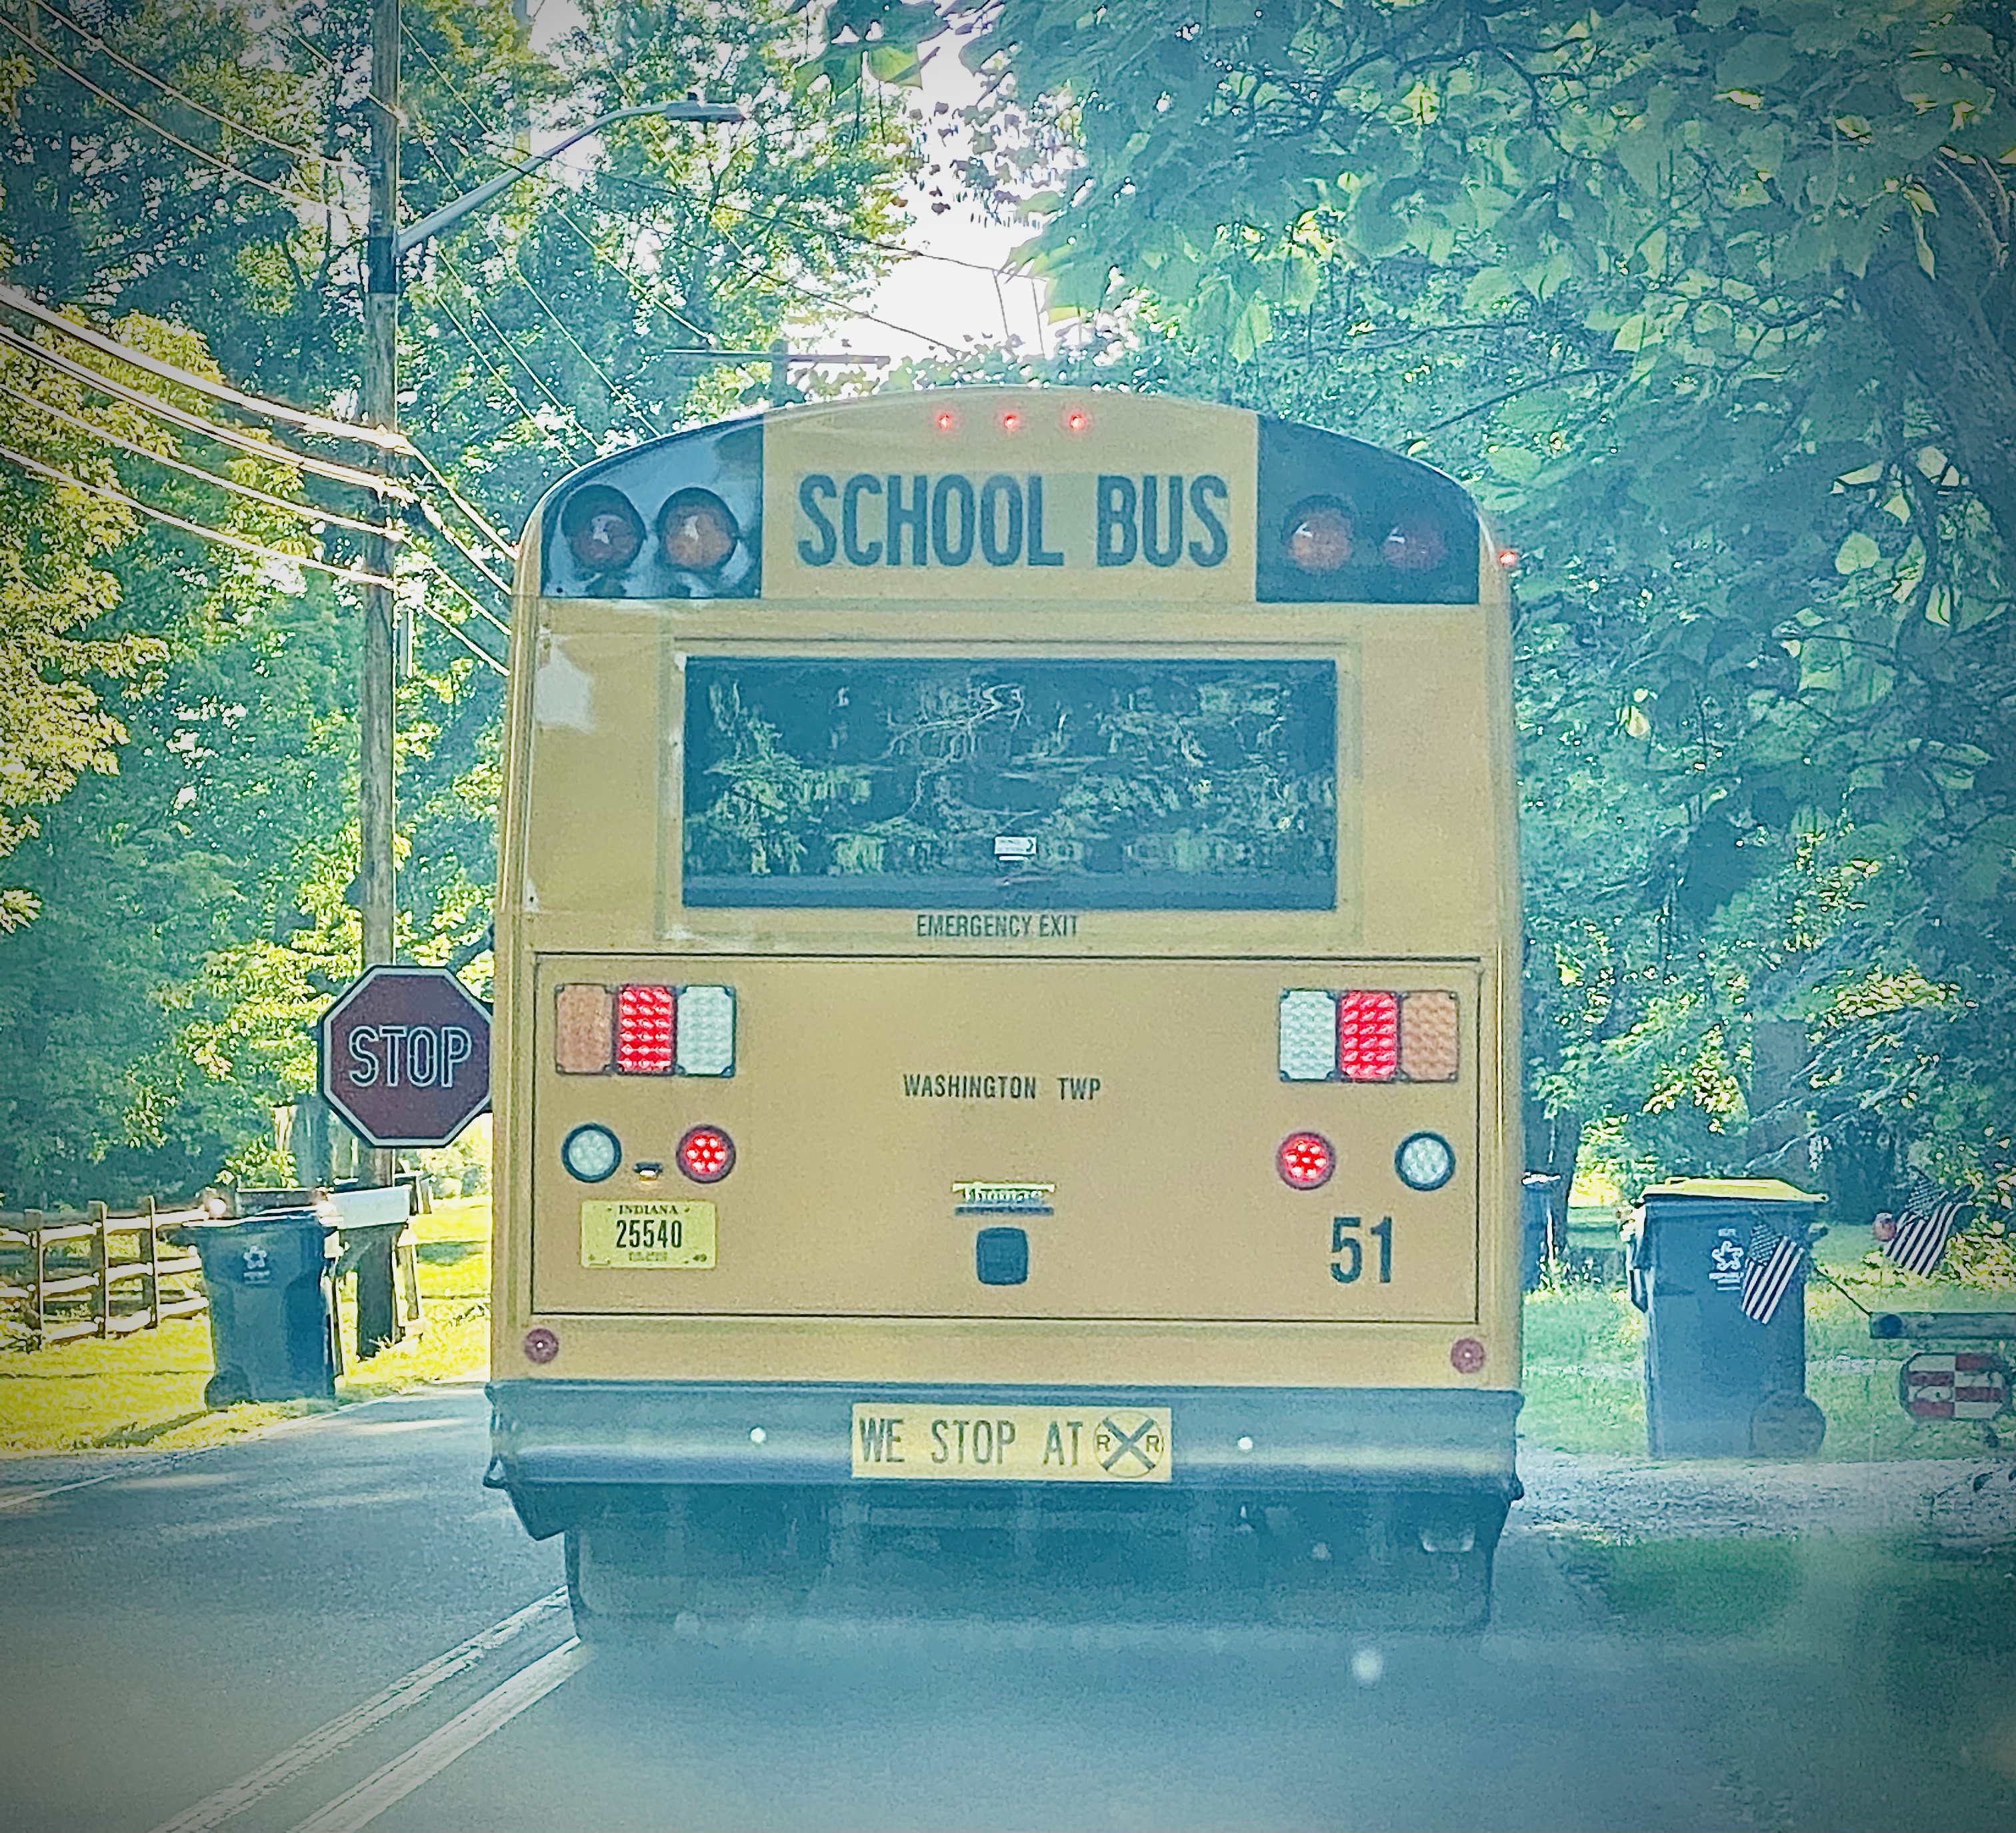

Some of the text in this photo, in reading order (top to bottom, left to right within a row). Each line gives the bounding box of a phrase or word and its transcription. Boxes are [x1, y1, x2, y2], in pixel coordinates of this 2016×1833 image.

[798, 473, 1228, 567] SCHOOL BUS
[917, 914, 1077, 937] EMERGENCY EXIT
[348, 1025, 472, 1088] STOP
[903, 1074, 1101, 1100] WASHINGTON TWP
[619, 1204, 679, 1215] INDIANA
[616, 1219, 683, 1249] 25540
[1329, 1216, 1393, 1284] 51
[859, 1417, 905, 1463] WE
[931, 1419, 1016, 1465] STOP
[1043, 1420, 1083, 1466] AT
